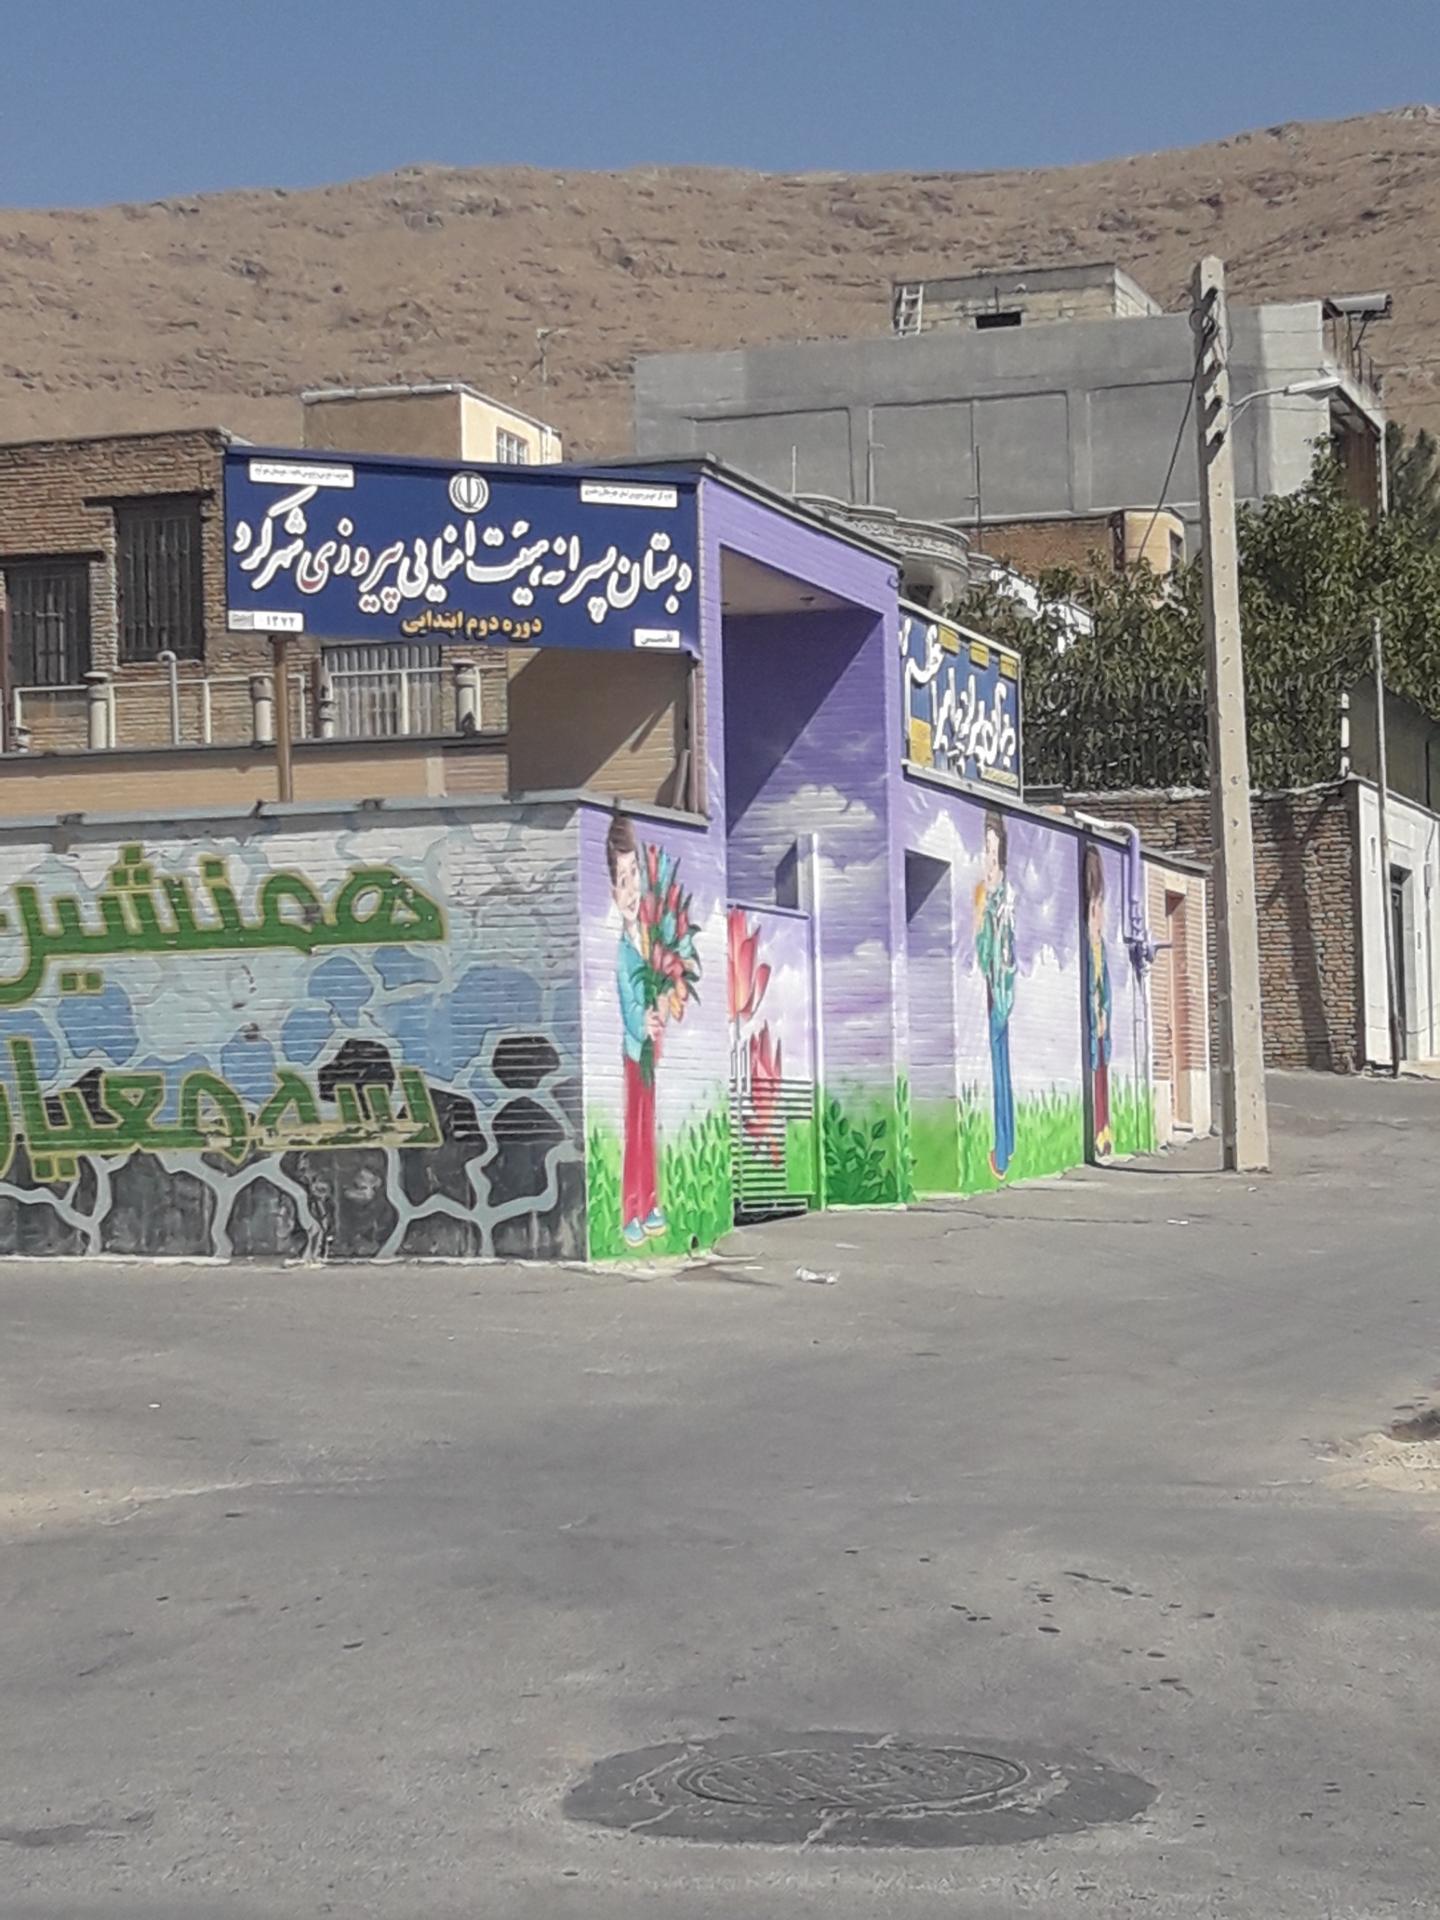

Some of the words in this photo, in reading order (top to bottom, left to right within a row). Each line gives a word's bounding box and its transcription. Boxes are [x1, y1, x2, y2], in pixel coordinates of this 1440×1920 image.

[232, 486, 319, 591] شهرکرد
[297, 517, 405, 614] پیروزی
[397, 519, 476, 602] امنایی
[541, 535, 617, 624] پسرانه
[607, 532, 692, 614] دبستان
[401, 609, 464, 636] ابتدایی
[465, 615, 499, 637] دوم
[501, 617, 543, 639] دوره
